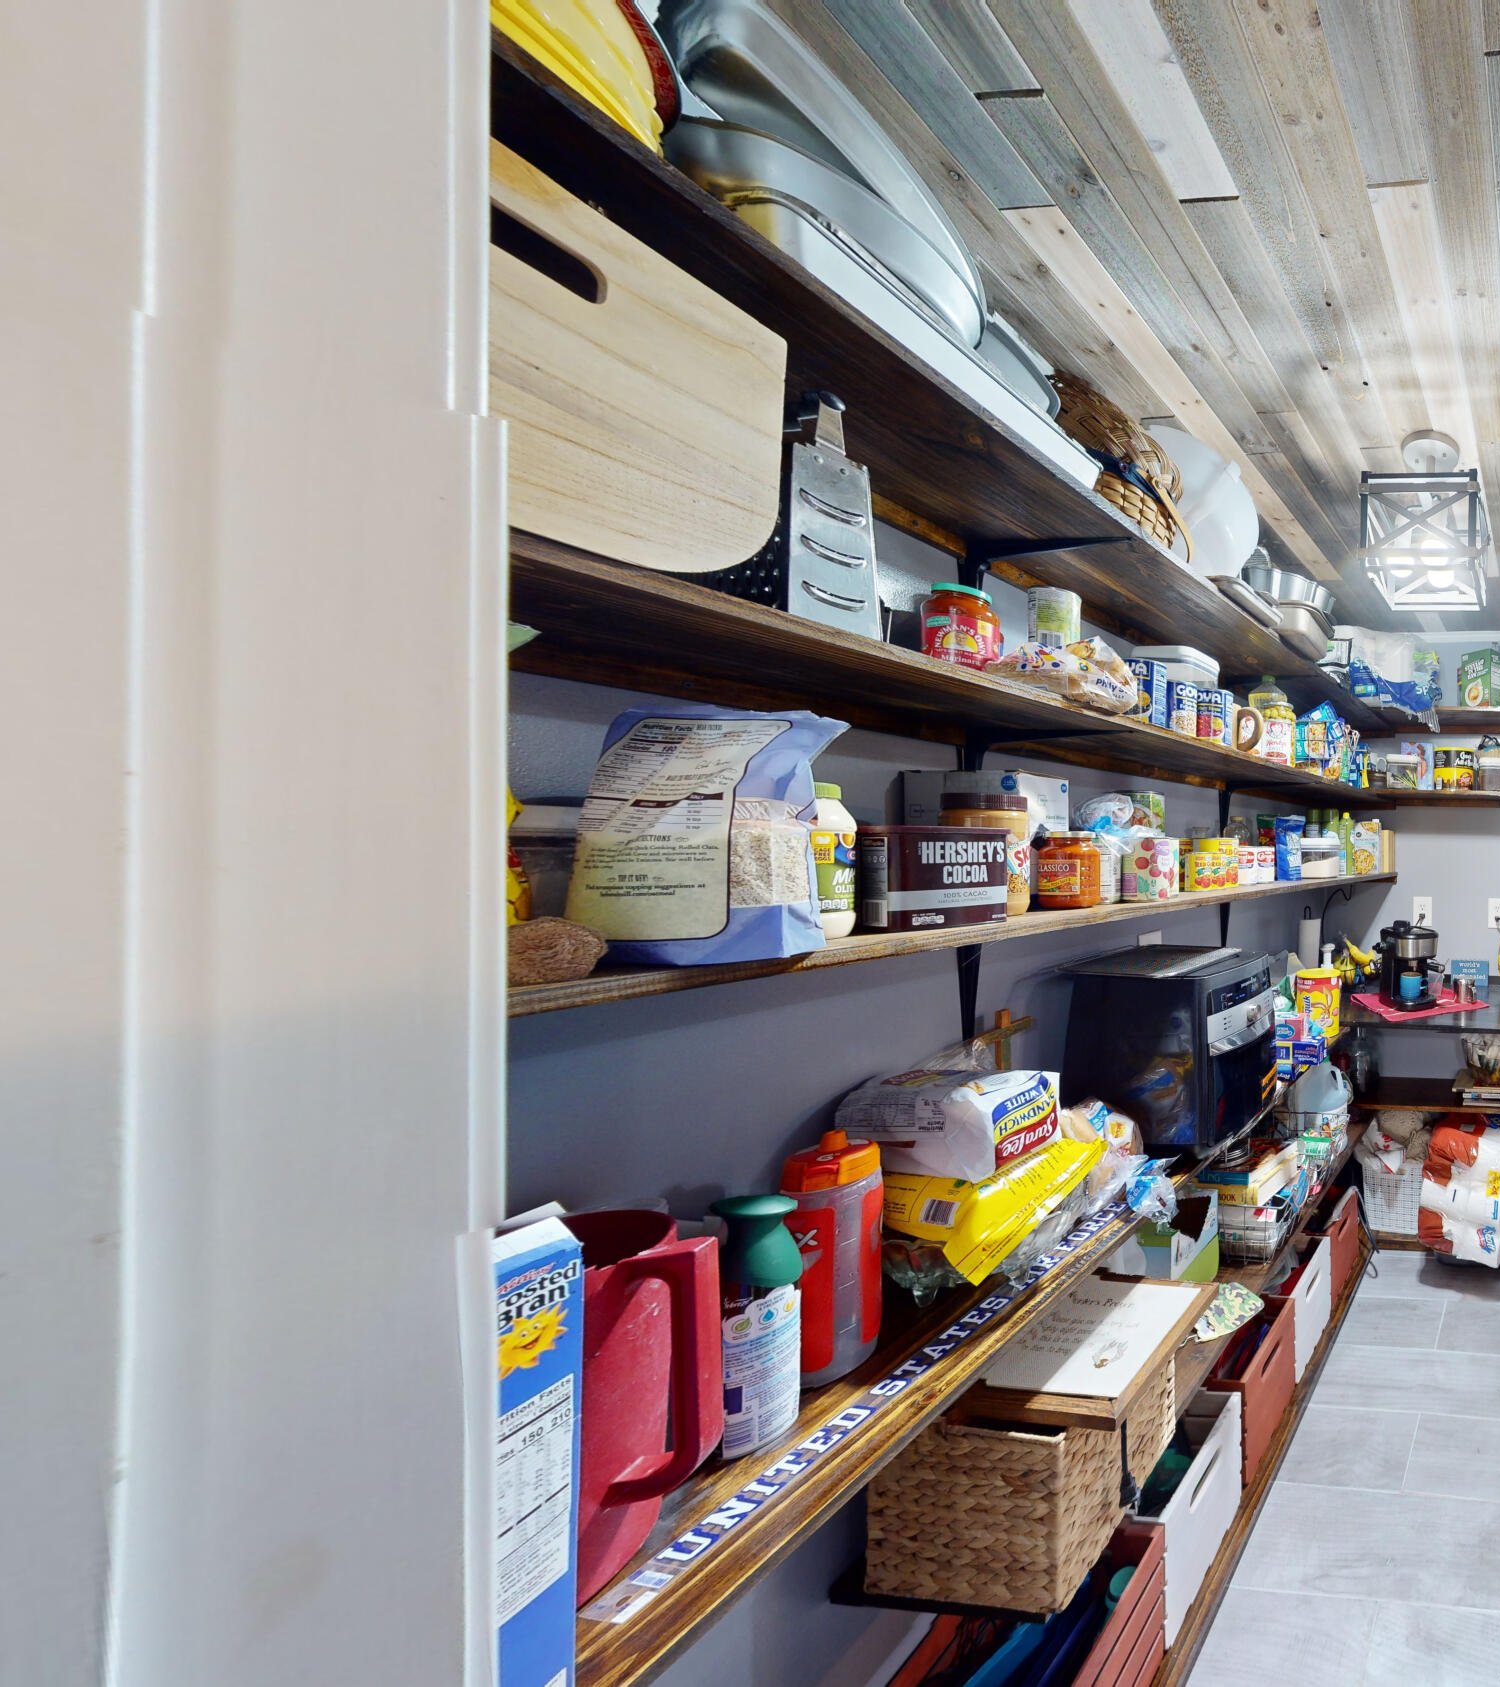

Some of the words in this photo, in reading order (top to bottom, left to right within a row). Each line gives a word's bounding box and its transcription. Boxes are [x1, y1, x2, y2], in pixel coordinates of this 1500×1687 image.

[934, 624, 976, 649] NEWMAN'S
[974, 634, 988, 655] OWN
[941, 654, 981, 666] Marinara
[1128, 662, 1148, 676] YA
[920, 841, 1005, 865] HERSHEY'S
[943, 865, 989, 884] COCOA
[963, 889, 988, 898] CACAO
[1004, 1084, 1044, 1111] WHITE
[497, 1284, 567, 1332] Bran
[539, 1377, 571, 1401] Facts
[657, 1405, 873, 1563] UNITED
[871, 1296, 1010, 1398] STATES
[1055, 1200, 1129, 1252] FORCE
[521, 1425, 544, 1446] 150
[550, 1407, 571, 1428] 210
